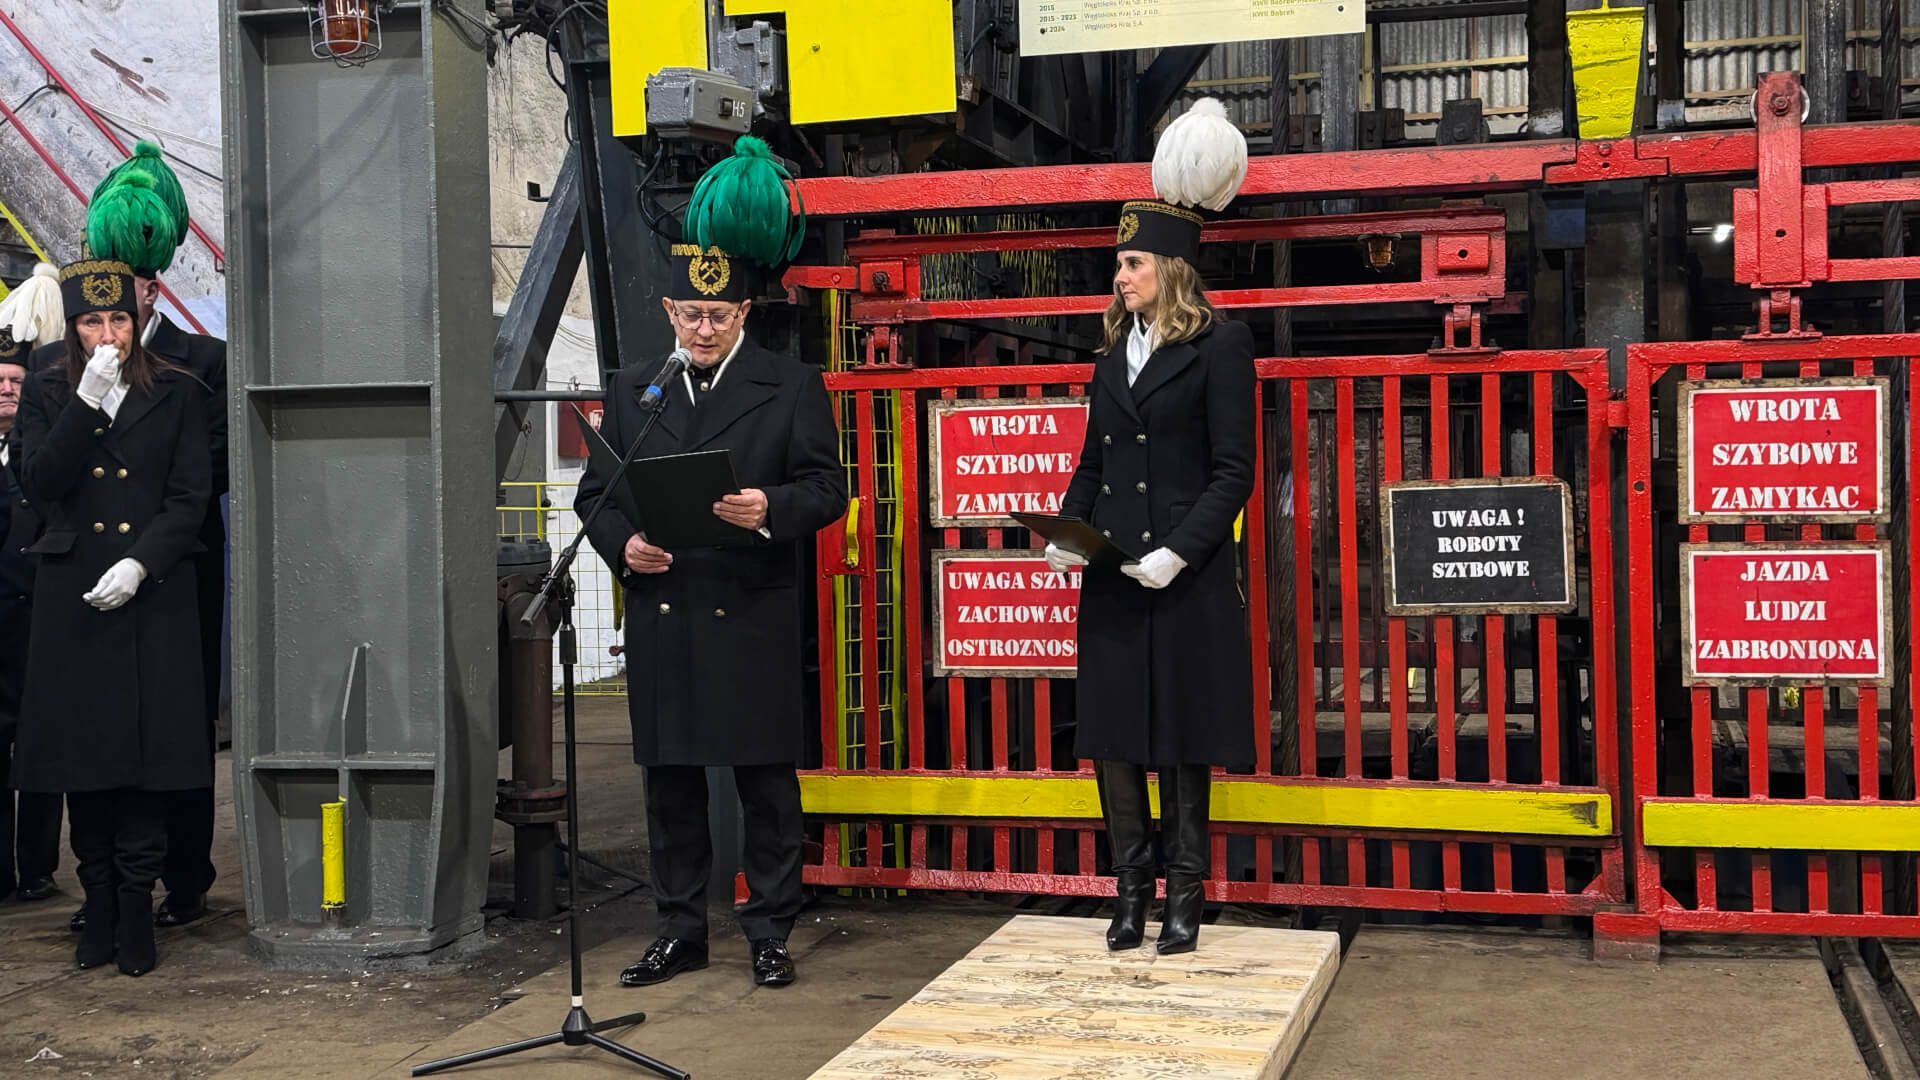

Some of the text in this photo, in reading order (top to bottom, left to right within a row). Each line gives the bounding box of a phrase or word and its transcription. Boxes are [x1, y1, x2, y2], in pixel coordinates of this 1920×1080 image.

[1039, 4, 1055, 12] 2015
[1728, 397, 1841, 422] WROTA
[968, 414, 1058, 437] WROTA
[956, 453, 1073, 475] SZYBOWE
[1712, 442, 1858, 466] SZYBOWE
[1711, 485, 1860, 510] ZAMYKAC
[1432, 508, 1525, 528] UWAGA !
[1437, 535, 1522, 553] ROBOTY
[1432, 561, 1530, 579] SZYBOWE
[1740, 560, 1830, 582] JAZDA
[948, 572, 1026, 590] UWAGA
[957, 605, 1077, 623] ZACHOWAC
[1744, 600, 1827, 621] LUDZI
[948, 639, 1078, 657] OSTROZNOS
[1698, 638, 1876, 660] ZABRONIONA
